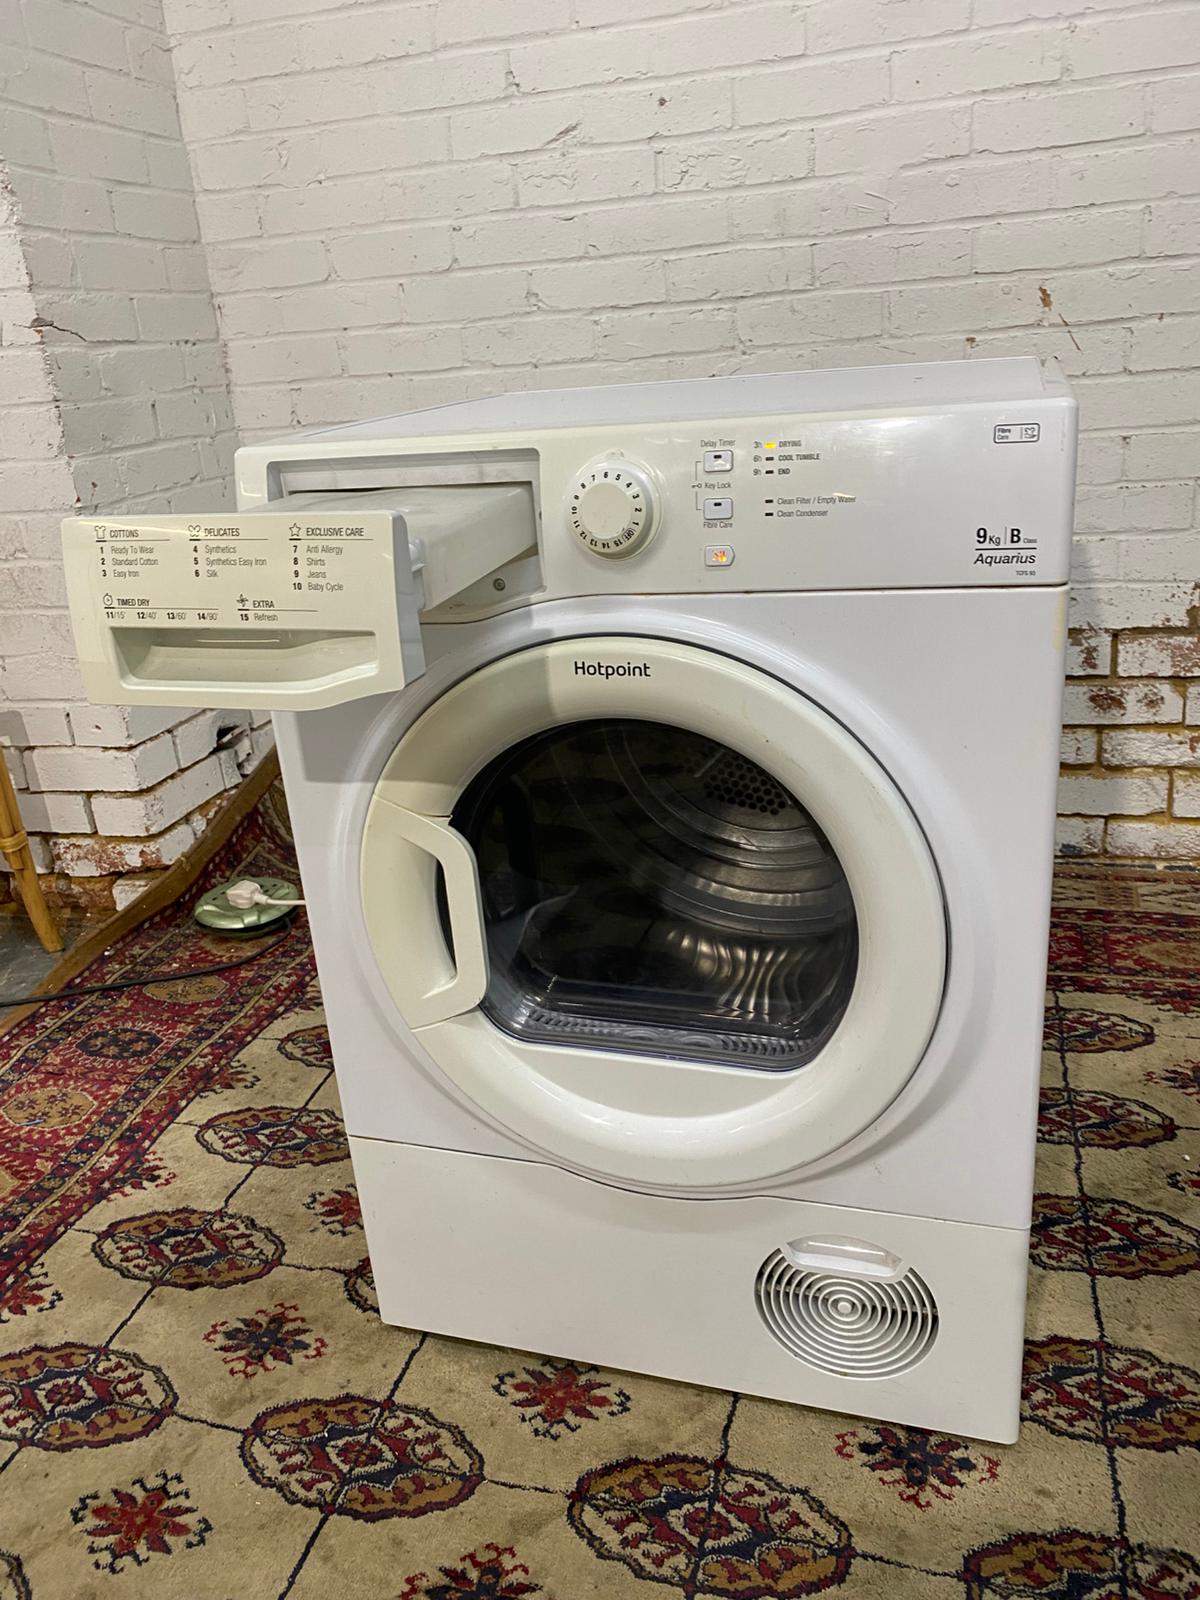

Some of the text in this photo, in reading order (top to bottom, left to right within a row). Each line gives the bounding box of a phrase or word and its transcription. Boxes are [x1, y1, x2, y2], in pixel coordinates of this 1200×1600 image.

[700, 440, 717, 448] Delay
[817, 497, 836, 505] Empty
[571, 506, 577, 514] 10
[573, 520, 580, 528] 11
[204, 528, 240, 536] DELICATES
[306, 528, 364, 536] EXCLUSIVE CARE
[580, 531, 587, 540] 12
[624, 530, 635, 540] OFF
[1010, 528, 1021, 543] B
[976, 528, 1000, 546] 9 Kg
[590, 539, 598, 547] 13
[614, 539, 623, 547] 15
[111, 546, 128, 555] Ready
[205, 545, 236, 555] Synthetics
[321, 545, 343, 555] Allergy
[206, 558, 237, 566] Synthetics
[238, 558, 253, 567] Easy
[306, 558, 326, 566] Shirts
[974, 553, 1036, 566] Aquarius
[113, 570, 126, 579] Easy
[308, 582, 324, 592] Baby
[326, 582, 343, 592] Cycle
[574, 661, 651, 679] Hotpoint
